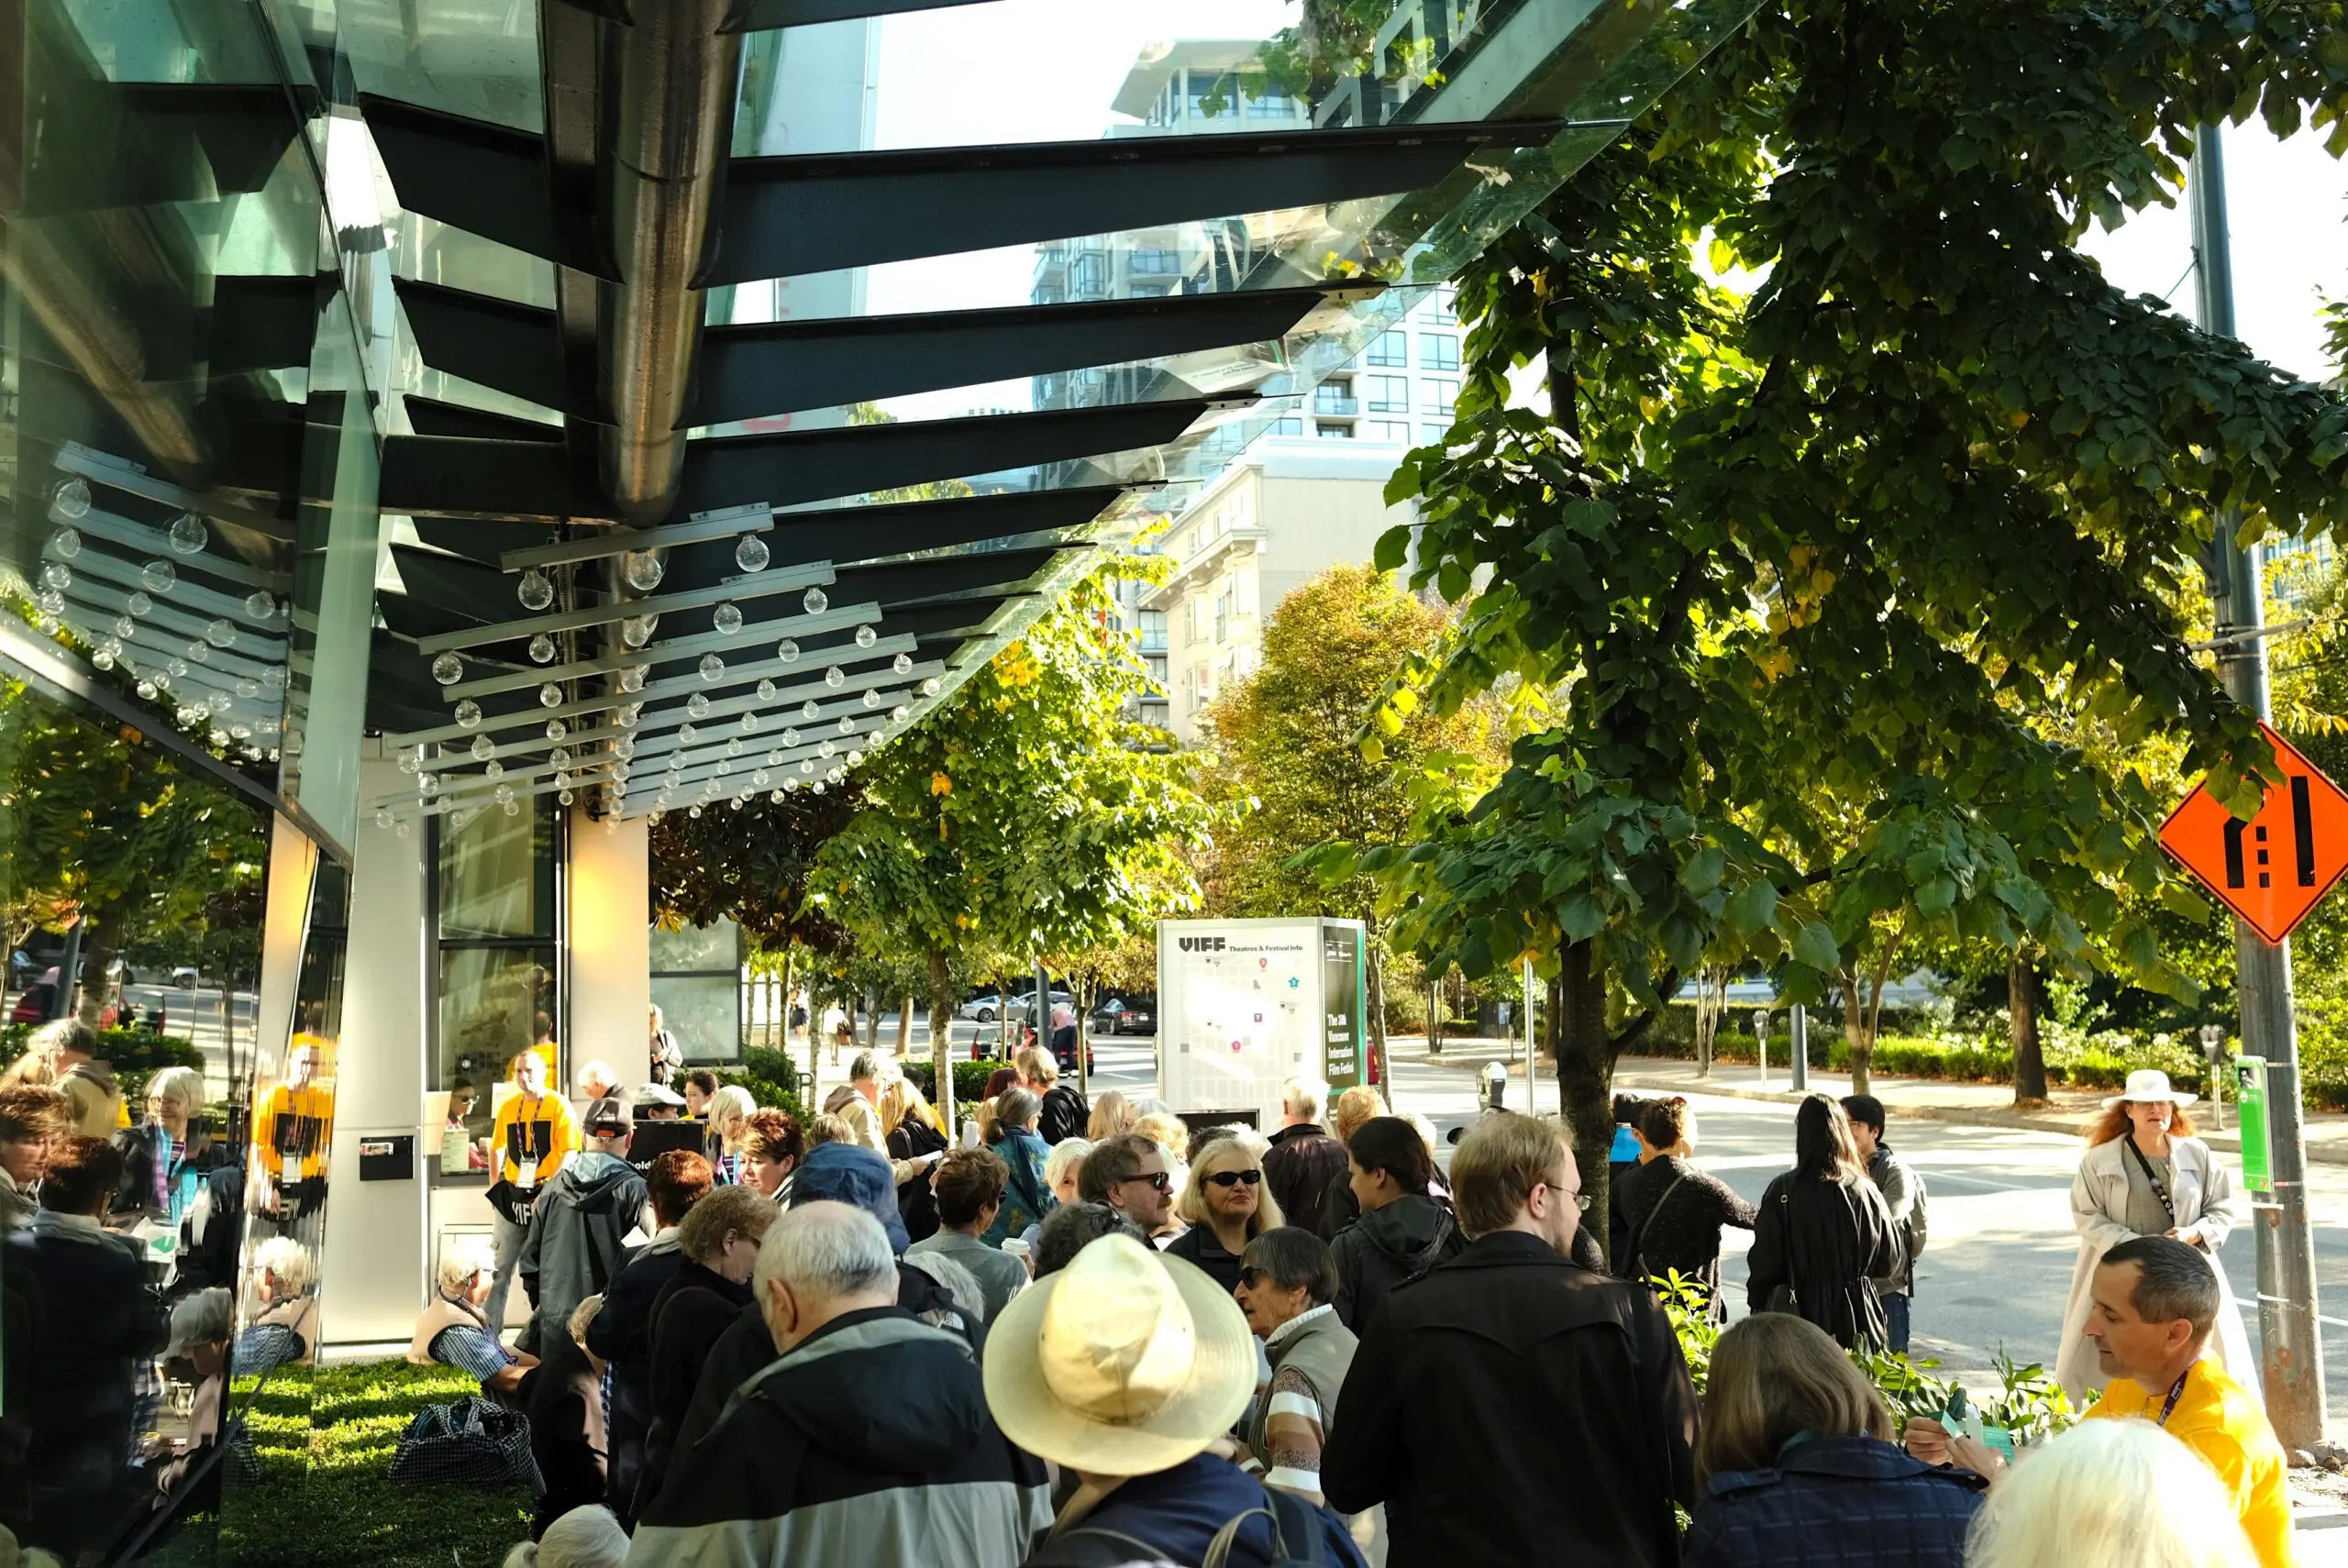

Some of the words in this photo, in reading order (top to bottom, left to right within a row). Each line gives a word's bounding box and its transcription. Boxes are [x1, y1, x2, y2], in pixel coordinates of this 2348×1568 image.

[1179, 937, 1225, 952] VIFF
[1327, 1013, 1338, 1026] The
[1327, 1030, 1350, 1043] Vancouver
[1328, 1044, 1354, 1059] International
[1328, 1063, 1340, 1076] Film
[1340, 1060, 1355, 1075] Festival
